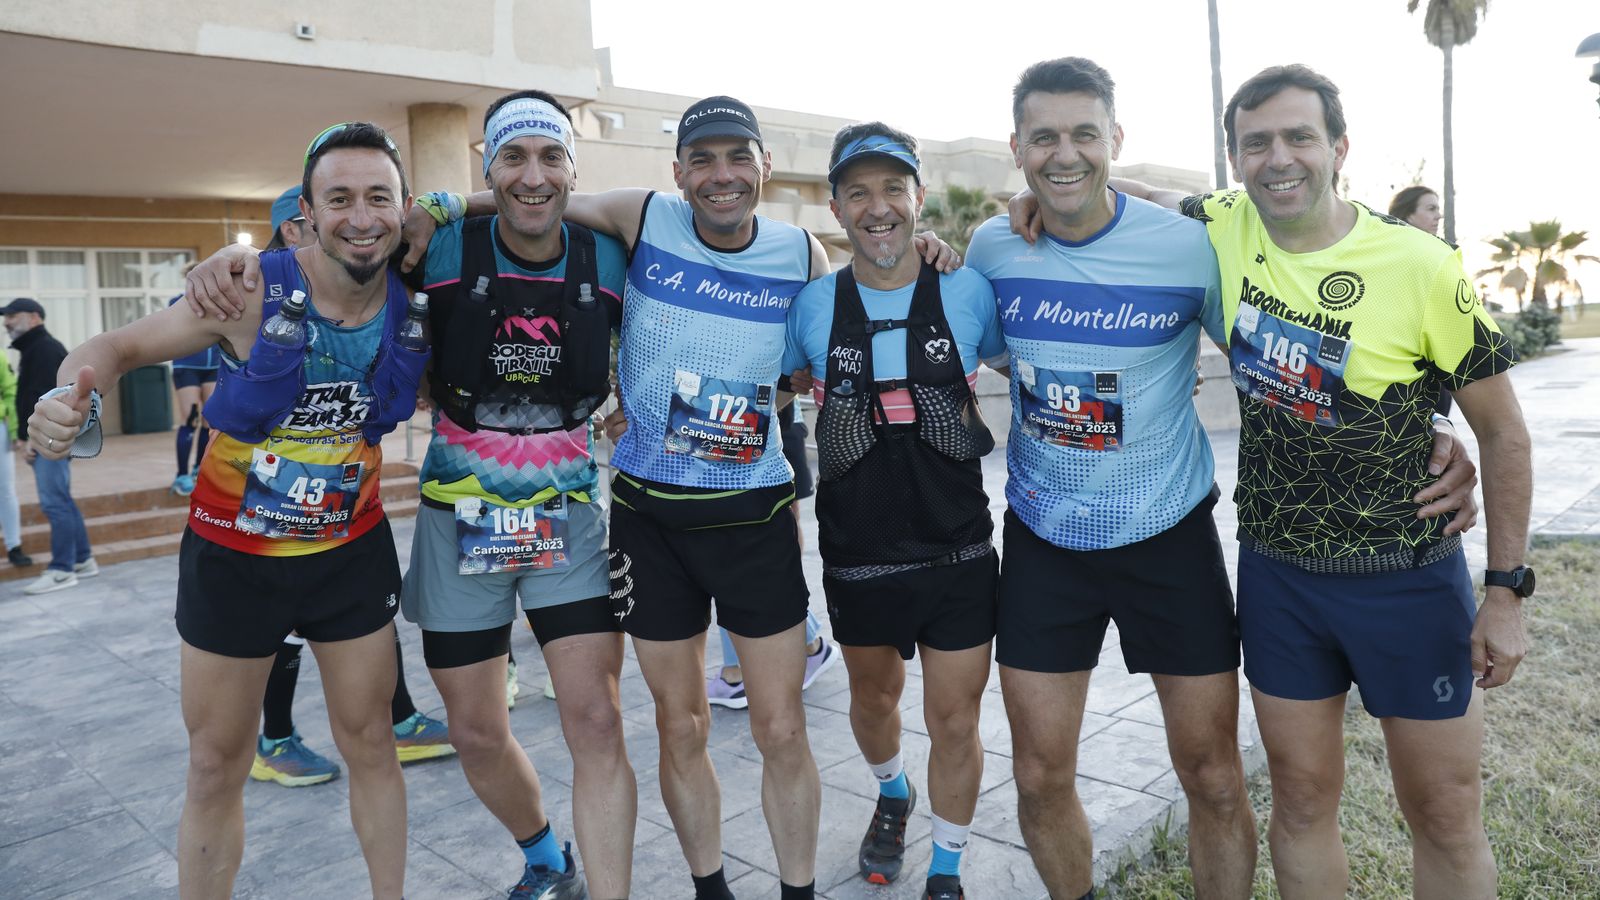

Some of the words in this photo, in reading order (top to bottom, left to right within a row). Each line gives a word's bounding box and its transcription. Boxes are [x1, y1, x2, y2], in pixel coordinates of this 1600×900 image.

[699, 108, 751, 122] LURBEL
[491, 119, 562, 147] NINGUNO
[646, 263, 686, 292] C.A.
[696, 279, 792, 310] Montellano
[1033, 299, 1179, 330] Montellano
[495, 359, 552, 375] TRAIL
[1262, 332, 1309, 375] 146
[1046, 383, 1081, 413] 93
[1239, 362, 1296, 396] Carbonera
[1299, 388, 1332, 407] 2023
[708, 393, 748, 425] 172
[1029, 412, 1083, 432] Carbonera
[1086, 424, 1117, 434] 2023
[680, 426, 740, 445] Carbonera
[742, 436, 763, 446] 2023
[287, 477, 328, 506] 43
[195, 507, 203, 519] El
[200, 512, 233, 529] Cerezo
[255, 505, 320, 525] Carbonera
[322, 512, 349, 525] 2023
[489, 505, 537, 535] 164
[472, 544, 533, 555] Carbonera
[535, 540, 564, 552] 2023
